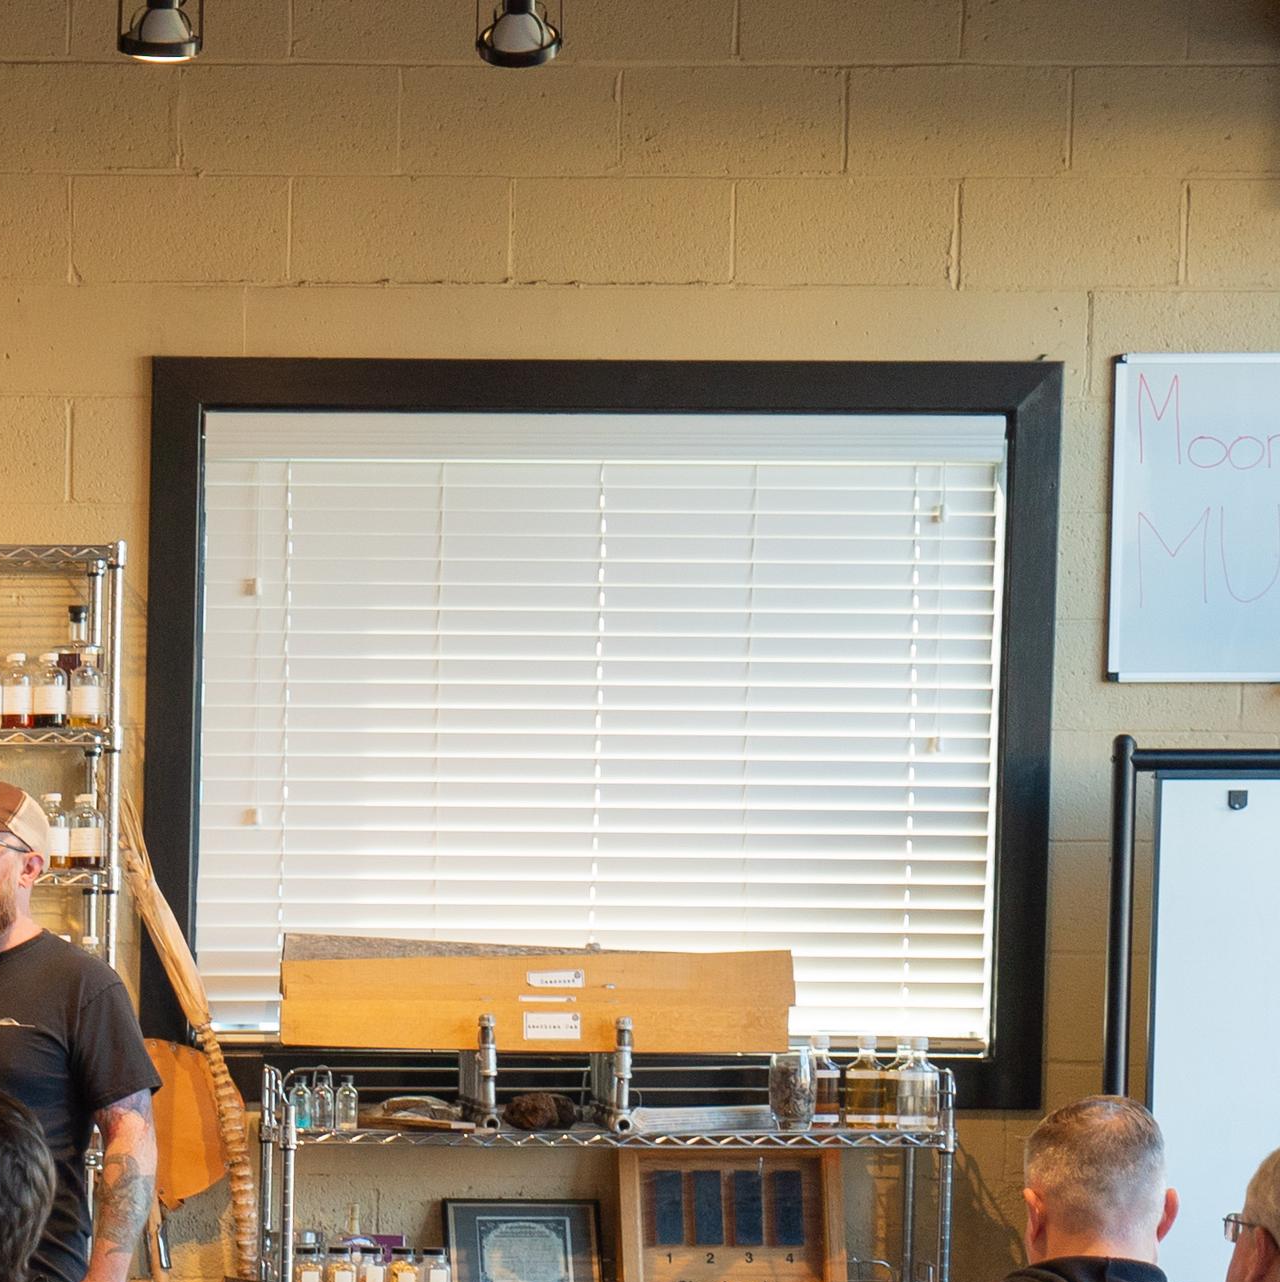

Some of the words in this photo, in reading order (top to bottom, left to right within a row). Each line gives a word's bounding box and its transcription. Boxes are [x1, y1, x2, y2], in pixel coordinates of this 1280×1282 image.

[666, 1253, 673, 1264] 1
[706, 1252, 715, 1265] 2
[745, 1252, 754, 1264] 3
[785, 1252, 795, 1264] 4
